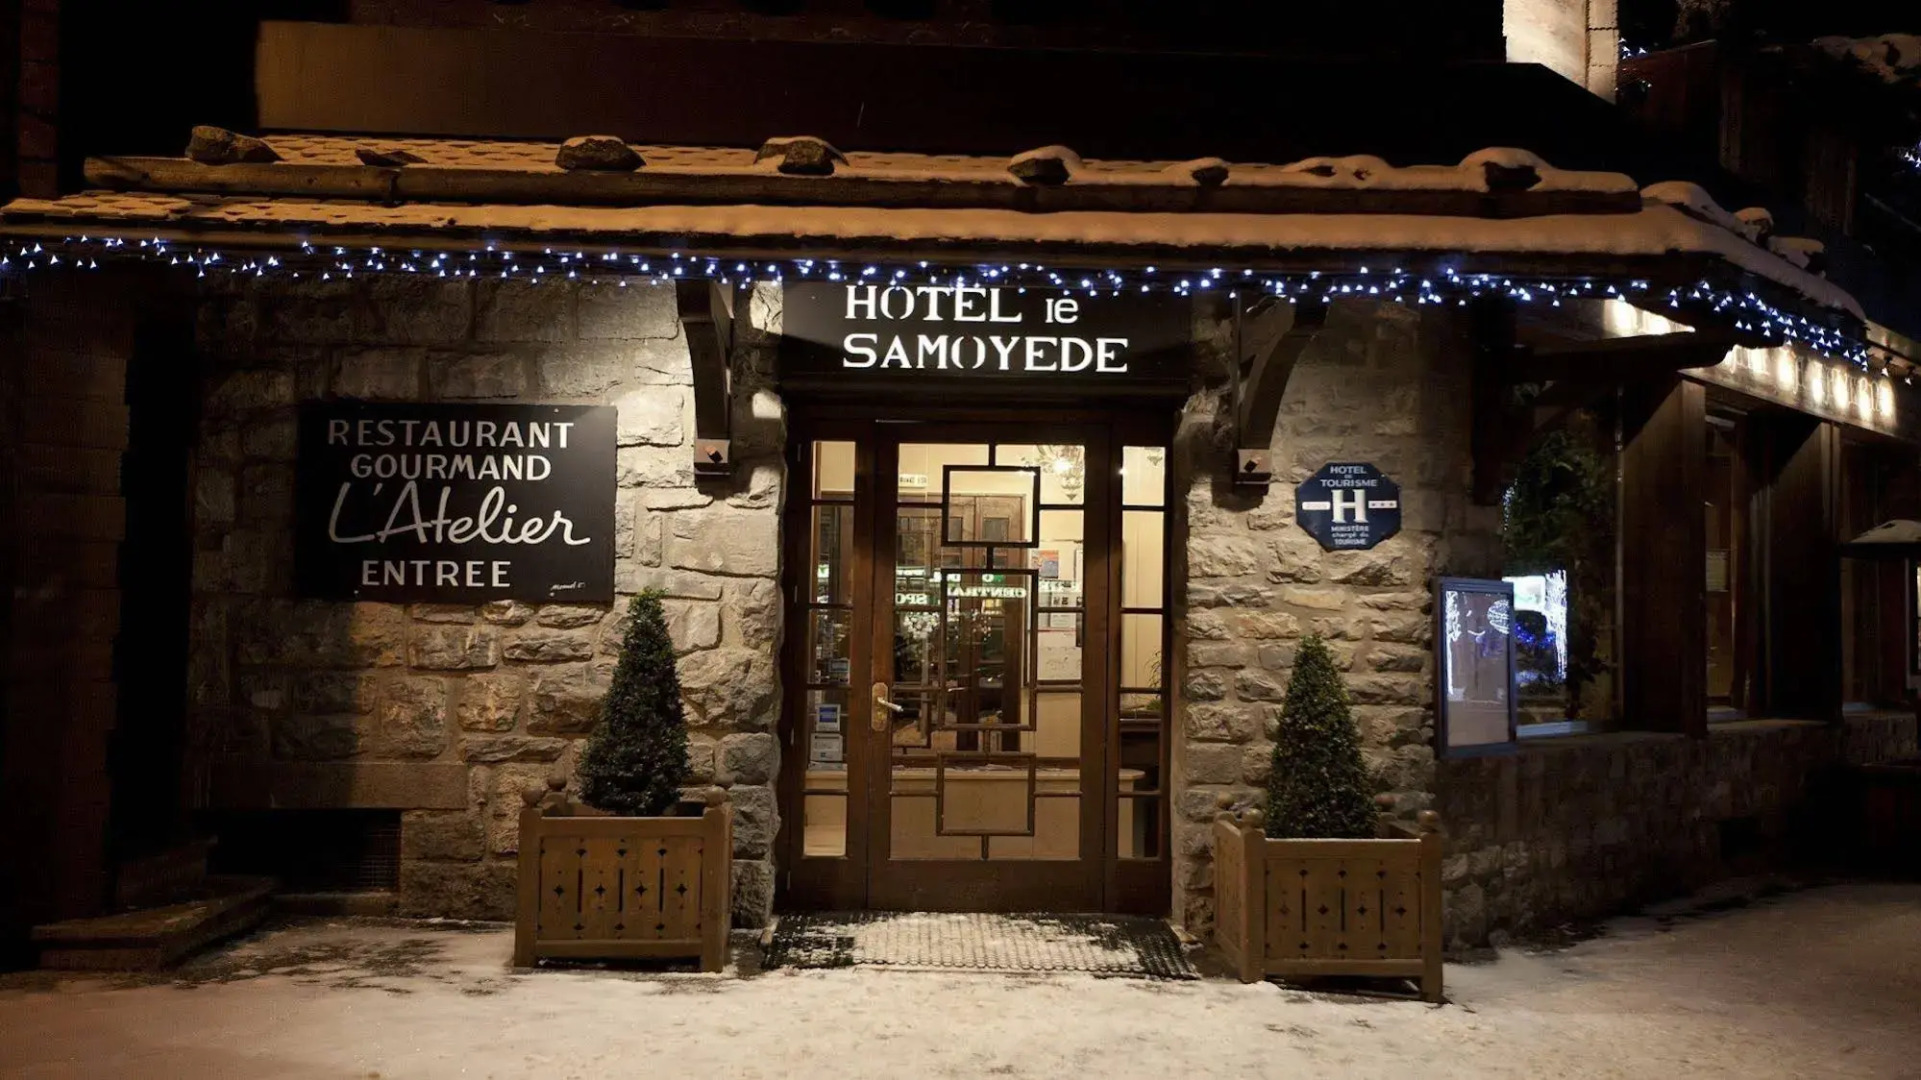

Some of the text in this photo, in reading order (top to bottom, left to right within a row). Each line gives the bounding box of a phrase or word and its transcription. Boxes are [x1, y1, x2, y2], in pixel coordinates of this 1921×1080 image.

[845, 285, 1022, 323] HOTEL
[843, 333, 1129, 373] SAMOYEDE
[328, 419, 574, 448] RESTAURANT
[351, 453, 552, 481] GOURMAND
[1330, 466, 1367, 474] HOTEL
[1320, 479, 1378, 487] TOURISME
[328, 480, 591, 546] L'Atelier
[1331, 489, 1369, 523] H
[361, 560, 512, 588] ENTREE
